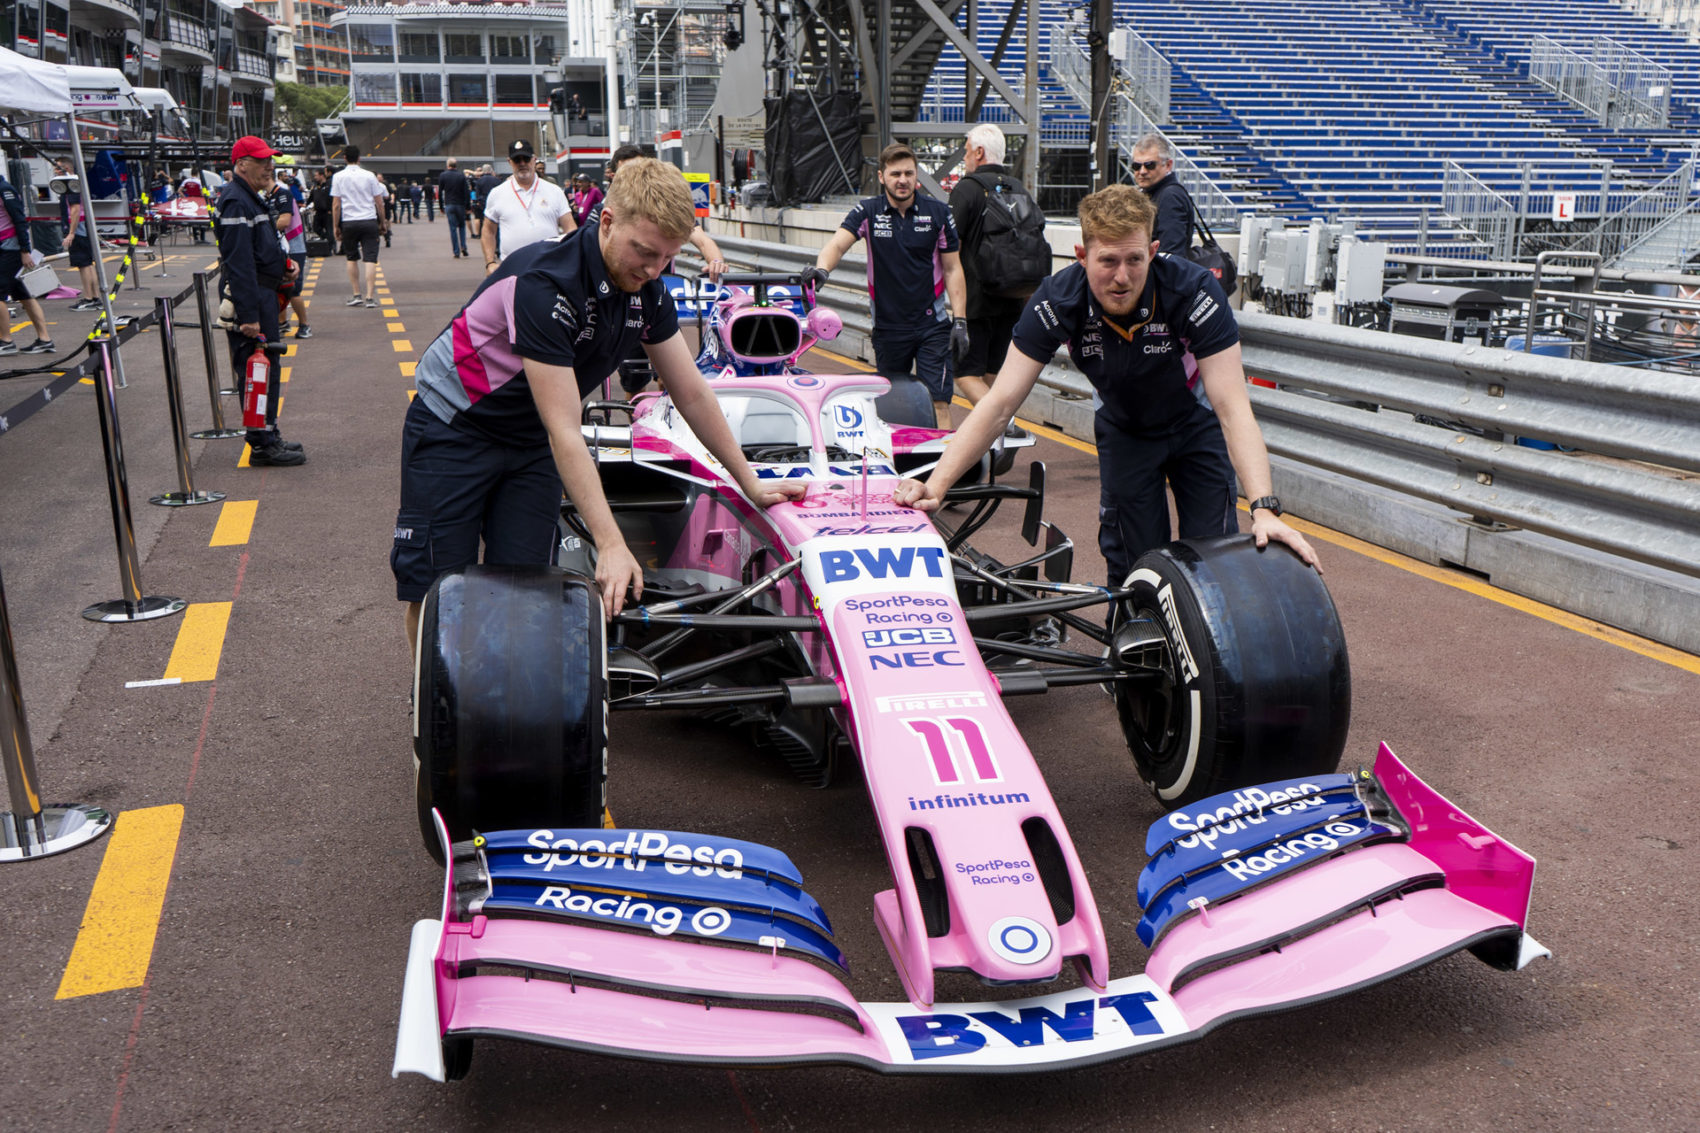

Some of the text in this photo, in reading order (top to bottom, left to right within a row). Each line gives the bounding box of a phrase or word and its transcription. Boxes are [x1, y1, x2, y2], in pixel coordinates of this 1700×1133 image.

[1559, 203, 1568, 217] L
[1082, 333, 1102, 343] NE
[819, 547, 944, 584] BWT
[845, 595, 949, 612] SportPesa
[865, 612, 933, 624] Racing
[864, 628, 955, 648] JCB
[869, 650, 965, 670] NEC
[875, 691, 988, 713] PIRELLI
[899, 715, 1004, 786] 11
[909, 792, 1030, 810] infinitum
[1169, 783, 1327, 850] SportPesa
[523, 829, 743, 880] SportPesa
[1222, 833, 1340, 881] Racing
[955, 859, 1031, 874] SportPesa
[971, 874, 1020, 885] Racing
[535, 886, 682, 935] Racing
[896, 991, 1164, 1060] BWT
